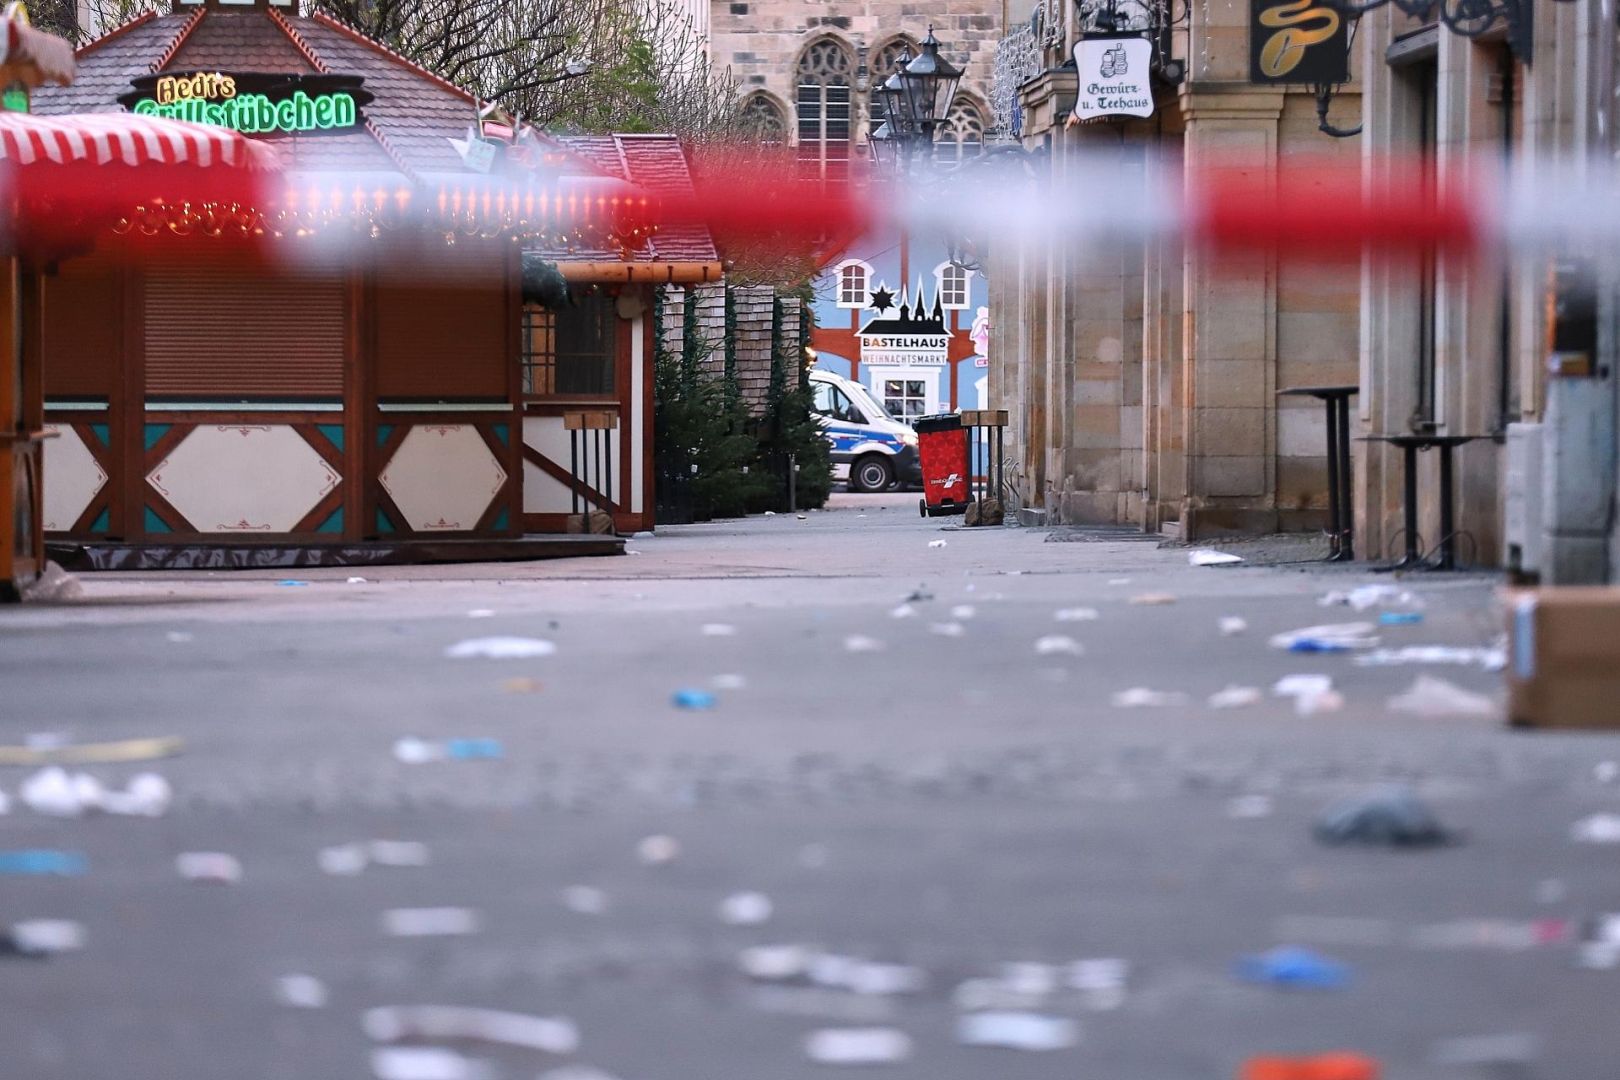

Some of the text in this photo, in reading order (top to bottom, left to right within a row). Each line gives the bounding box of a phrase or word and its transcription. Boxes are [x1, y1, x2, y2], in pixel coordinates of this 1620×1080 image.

[1087, 82, 1140, 95] Gewürz-
[1082, 97, 1149, 110] u. Teehaus
[863, 338, 946, 347] BASTELHAUS
[863, 354, 946, 364] WEIHNACHTSMARKT
